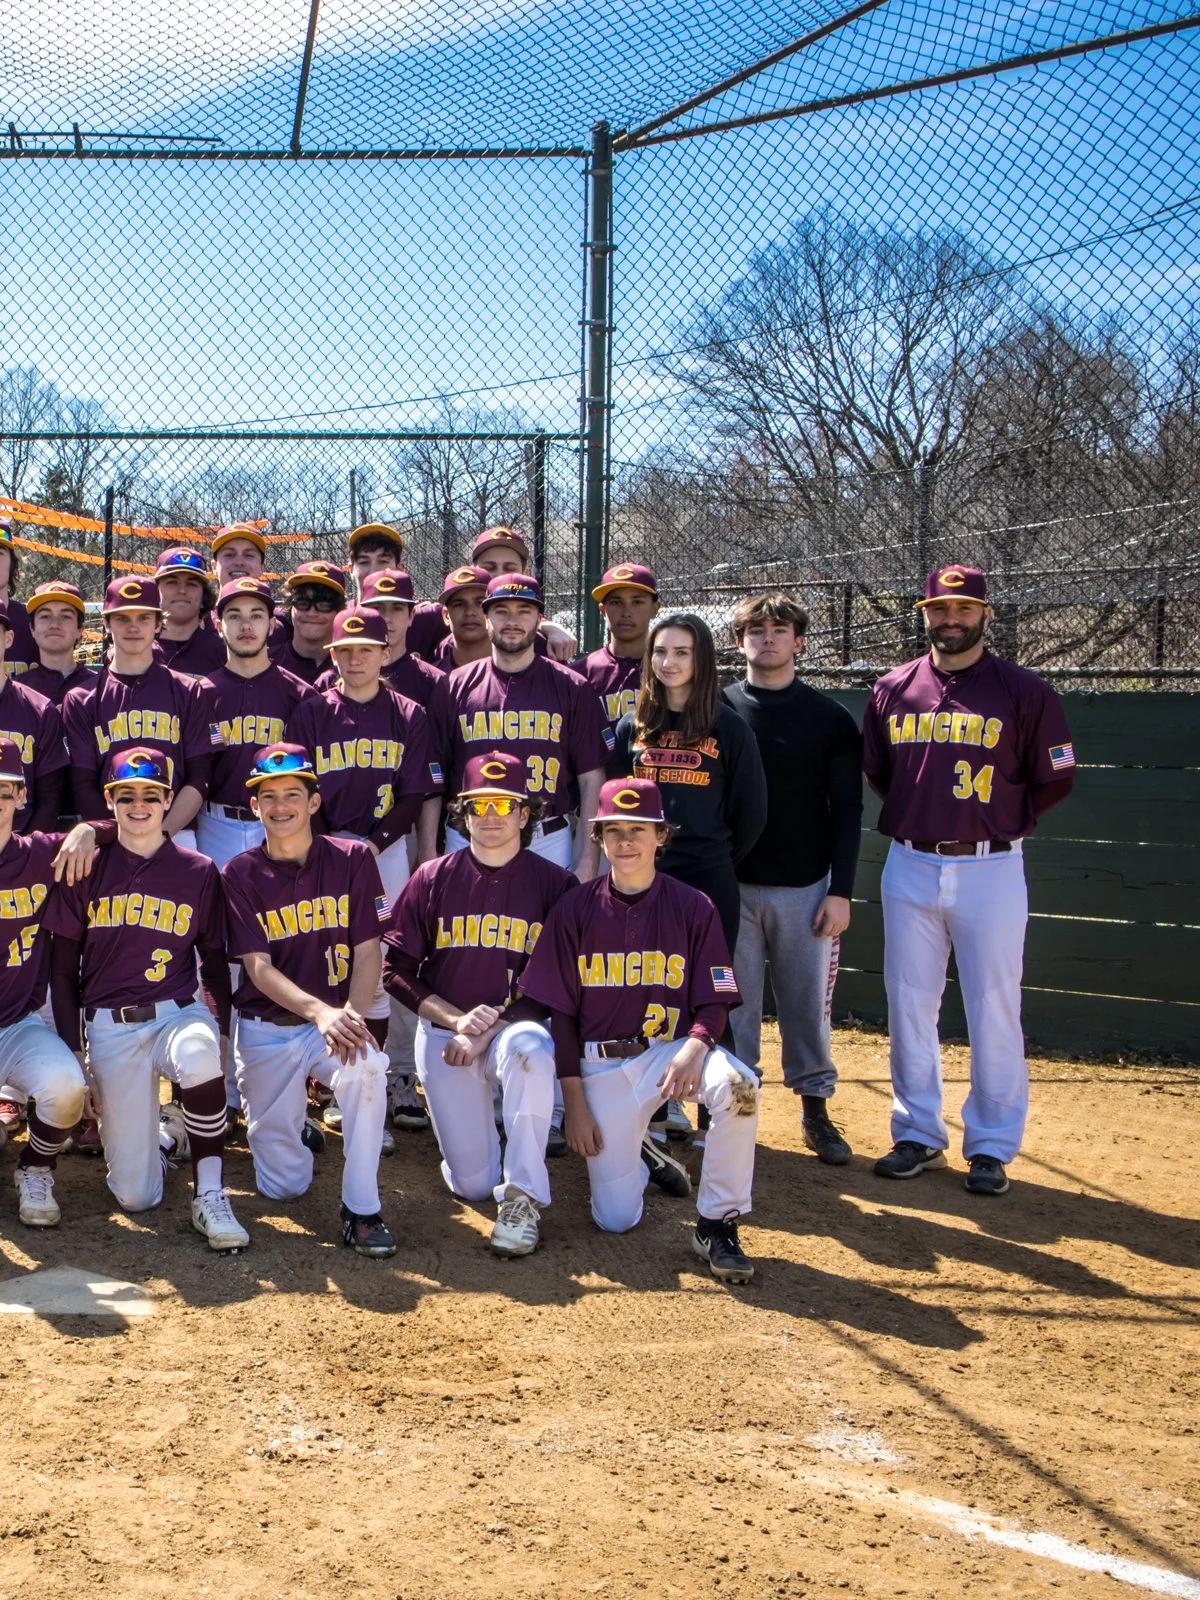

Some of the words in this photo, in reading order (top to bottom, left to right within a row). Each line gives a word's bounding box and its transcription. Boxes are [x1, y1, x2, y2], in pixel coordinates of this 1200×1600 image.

[308, 564, 330, 576] C
[454, 568, 476, 584] C
[612, 566, 635, 581] C
[938, 571, 965, 587] C
[118, 582, 142, 599] C
[235, 579, 258, 591] C
[374, 576, 397, 592] C
[342, 616, 365, 634] C
[219, 716, 288, 746] ANCER
[458, 710, 563, 744] LANCERS
[888, 712, 1003, 749] LANCERS
[670, 754, 697, 764] 1836
[480, 762, 506, 780] C
[526, 755, 560, 793] 39
[659, 768, 710, 786] SCHOOL
[952, 760, 994, 804] 34
[612, 790, 640, 809] C
[87, 893, 193, 936] LANCERS
[256, 894, 350, 943] LANCERS
[436, 914, 544, 955] LANCERS
[144, 948, 172, 981] 3
[578, 950, 686, 989] LANCERS
[642, 1003, 680, 1042] 21
